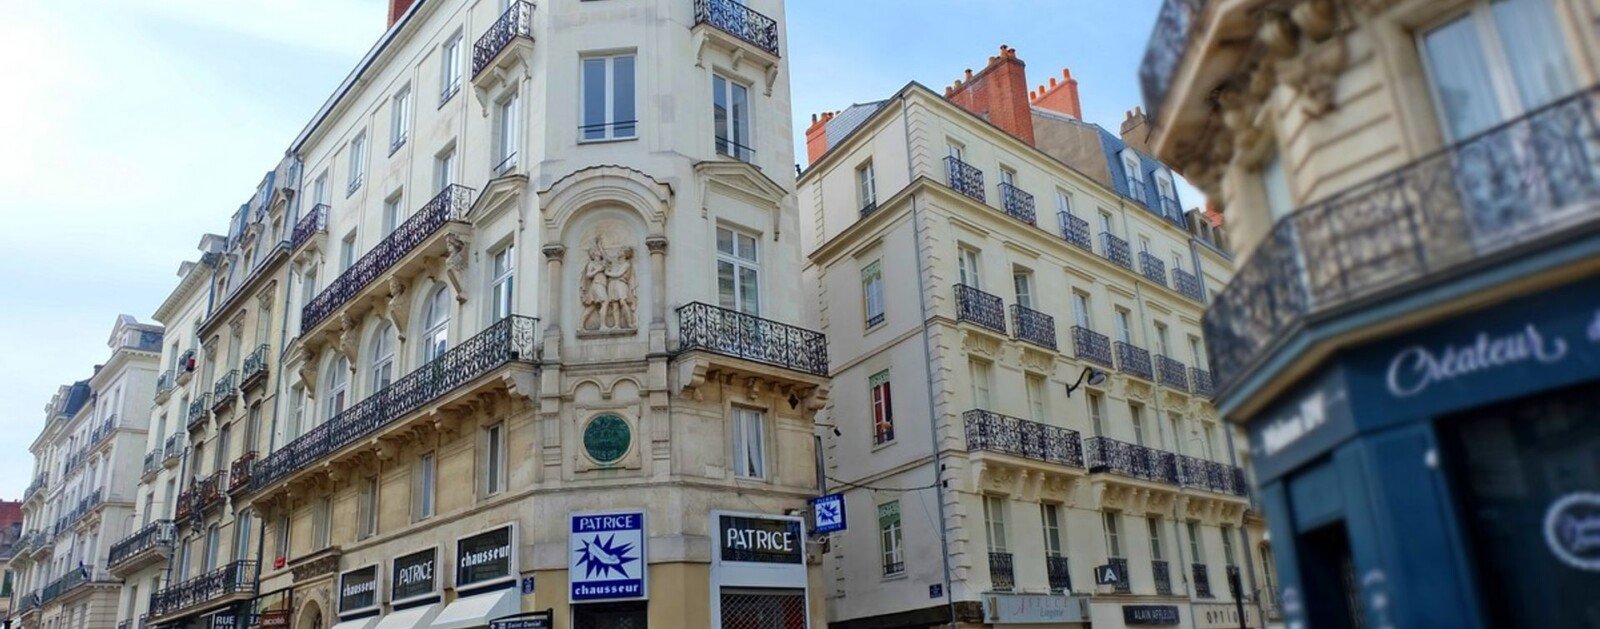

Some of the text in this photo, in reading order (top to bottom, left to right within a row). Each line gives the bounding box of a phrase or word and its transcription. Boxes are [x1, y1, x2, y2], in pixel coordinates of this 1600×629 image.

[1386, 323, 1568, 397] Créateur
[579, 515, 633, 530] PATRICE
[726, 528, 793, 551] PATRICE
[461, 545, 510, 568] chausseur
[399, 560, 433, 586] PATRICE
[1104, 568, 1117, 582] A
[575, 583, 639, 595] chausseur
[216, 615, 235, 624] RUE
